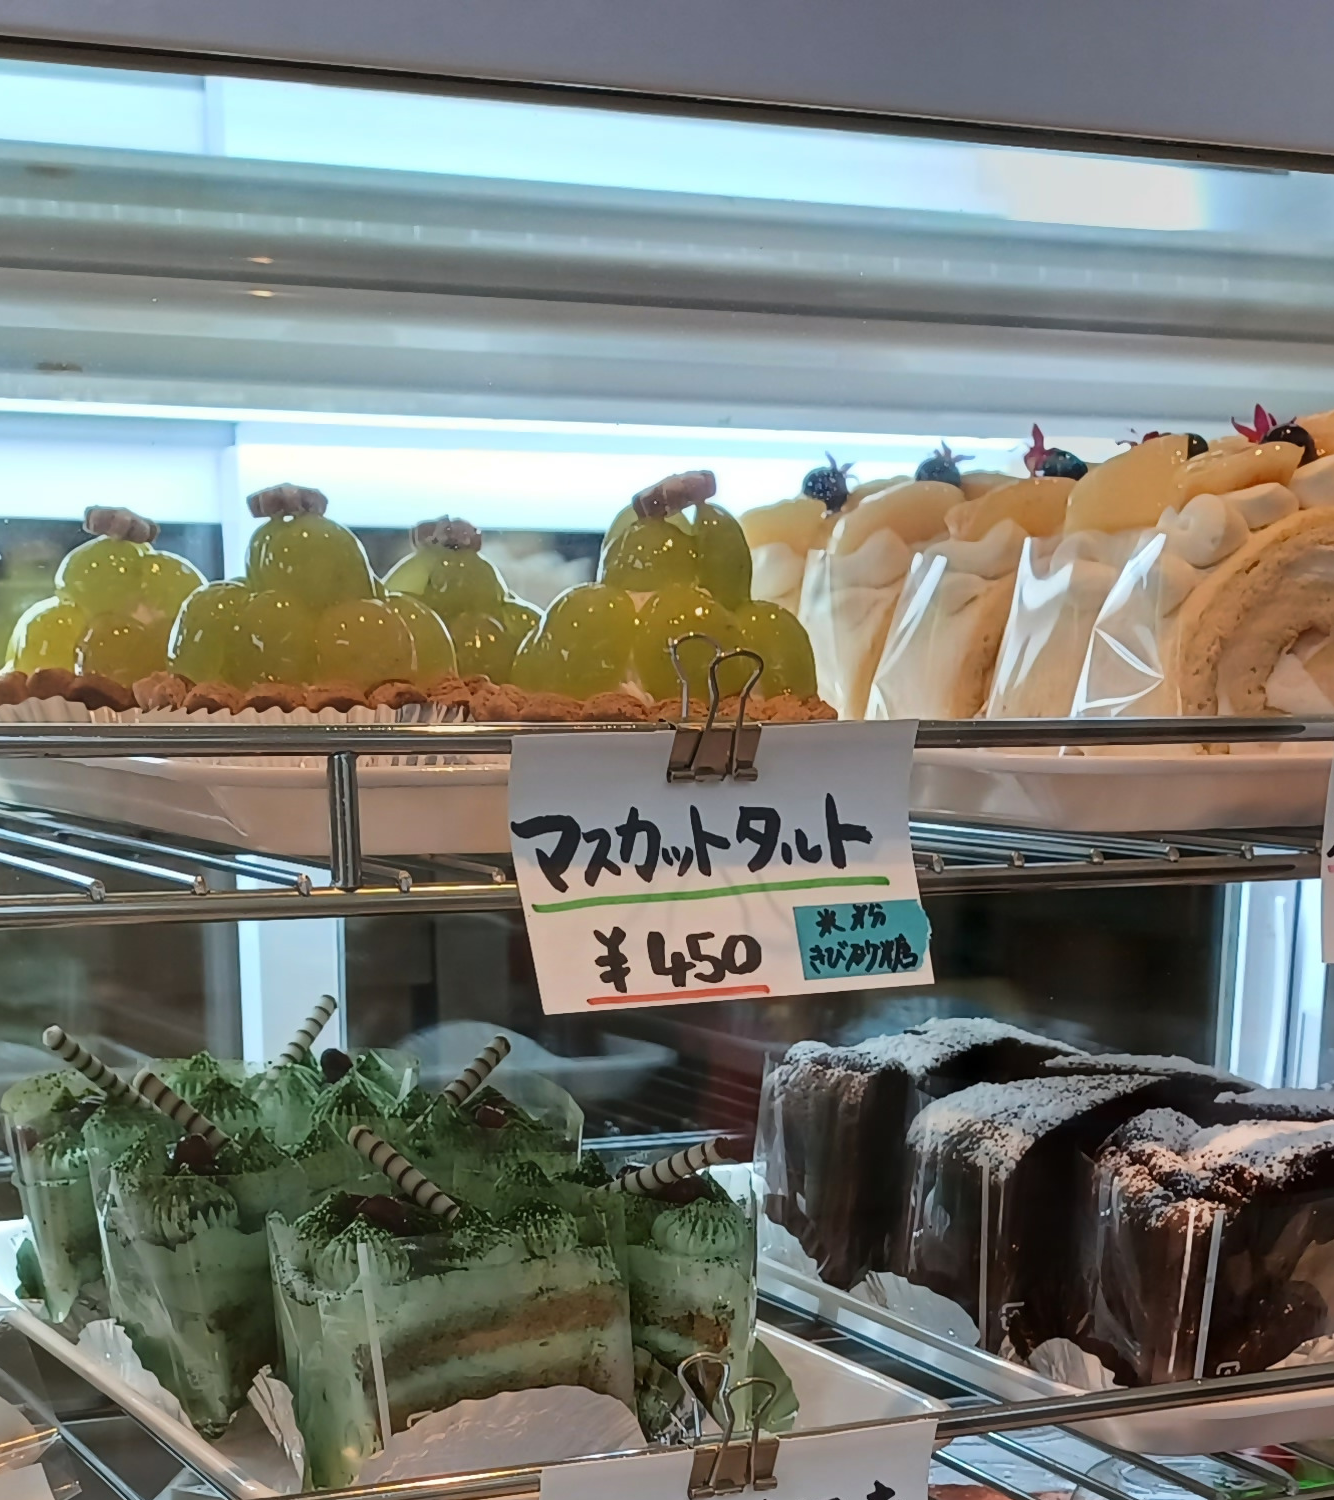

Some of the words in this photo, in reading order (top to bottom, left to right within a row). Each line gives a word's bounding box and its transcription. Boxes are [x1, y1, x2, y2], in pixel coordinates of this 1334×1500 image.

[510, 793, 873, 892] マスカットタルト
[815, 902, 887, 938] 米粉
[594, 926, 762, 993] ¥450
